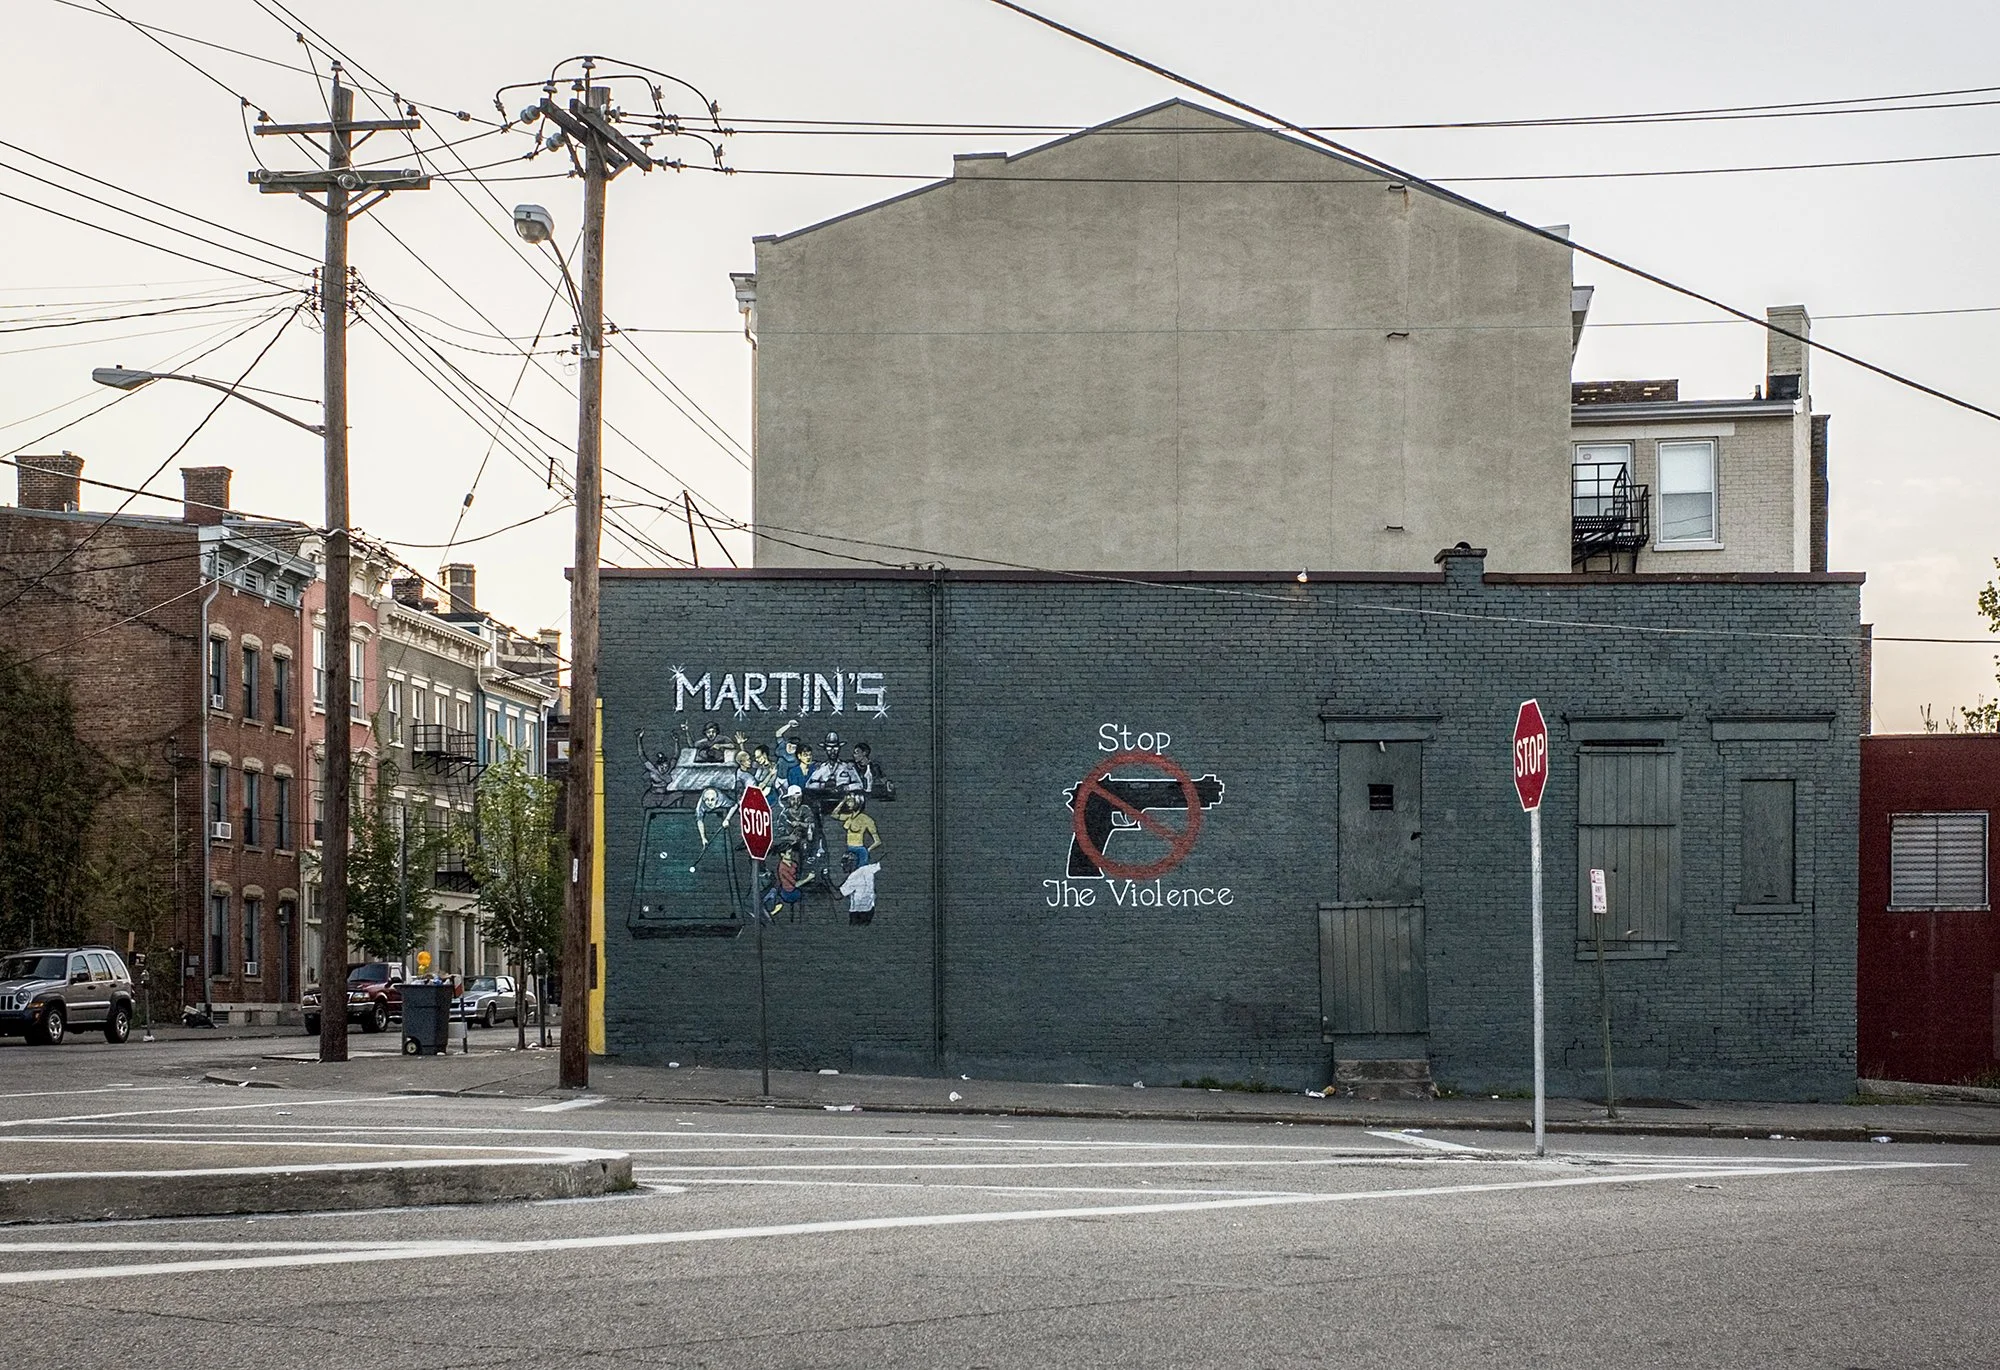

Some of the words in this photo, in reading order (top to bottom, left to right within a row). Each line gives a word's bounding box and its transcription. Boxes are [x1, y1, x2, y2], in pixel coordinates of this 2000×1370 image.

[670, 667, 888, 716] MARTIN'S
[1098, 723, 1171, 755] Stop
[1516, 733, 1544, 778] STOP
[743, 807, 770, 837] STOP
[1043, 880, 1096, 907] The
[1106, 879, 1234, 907] Violence
